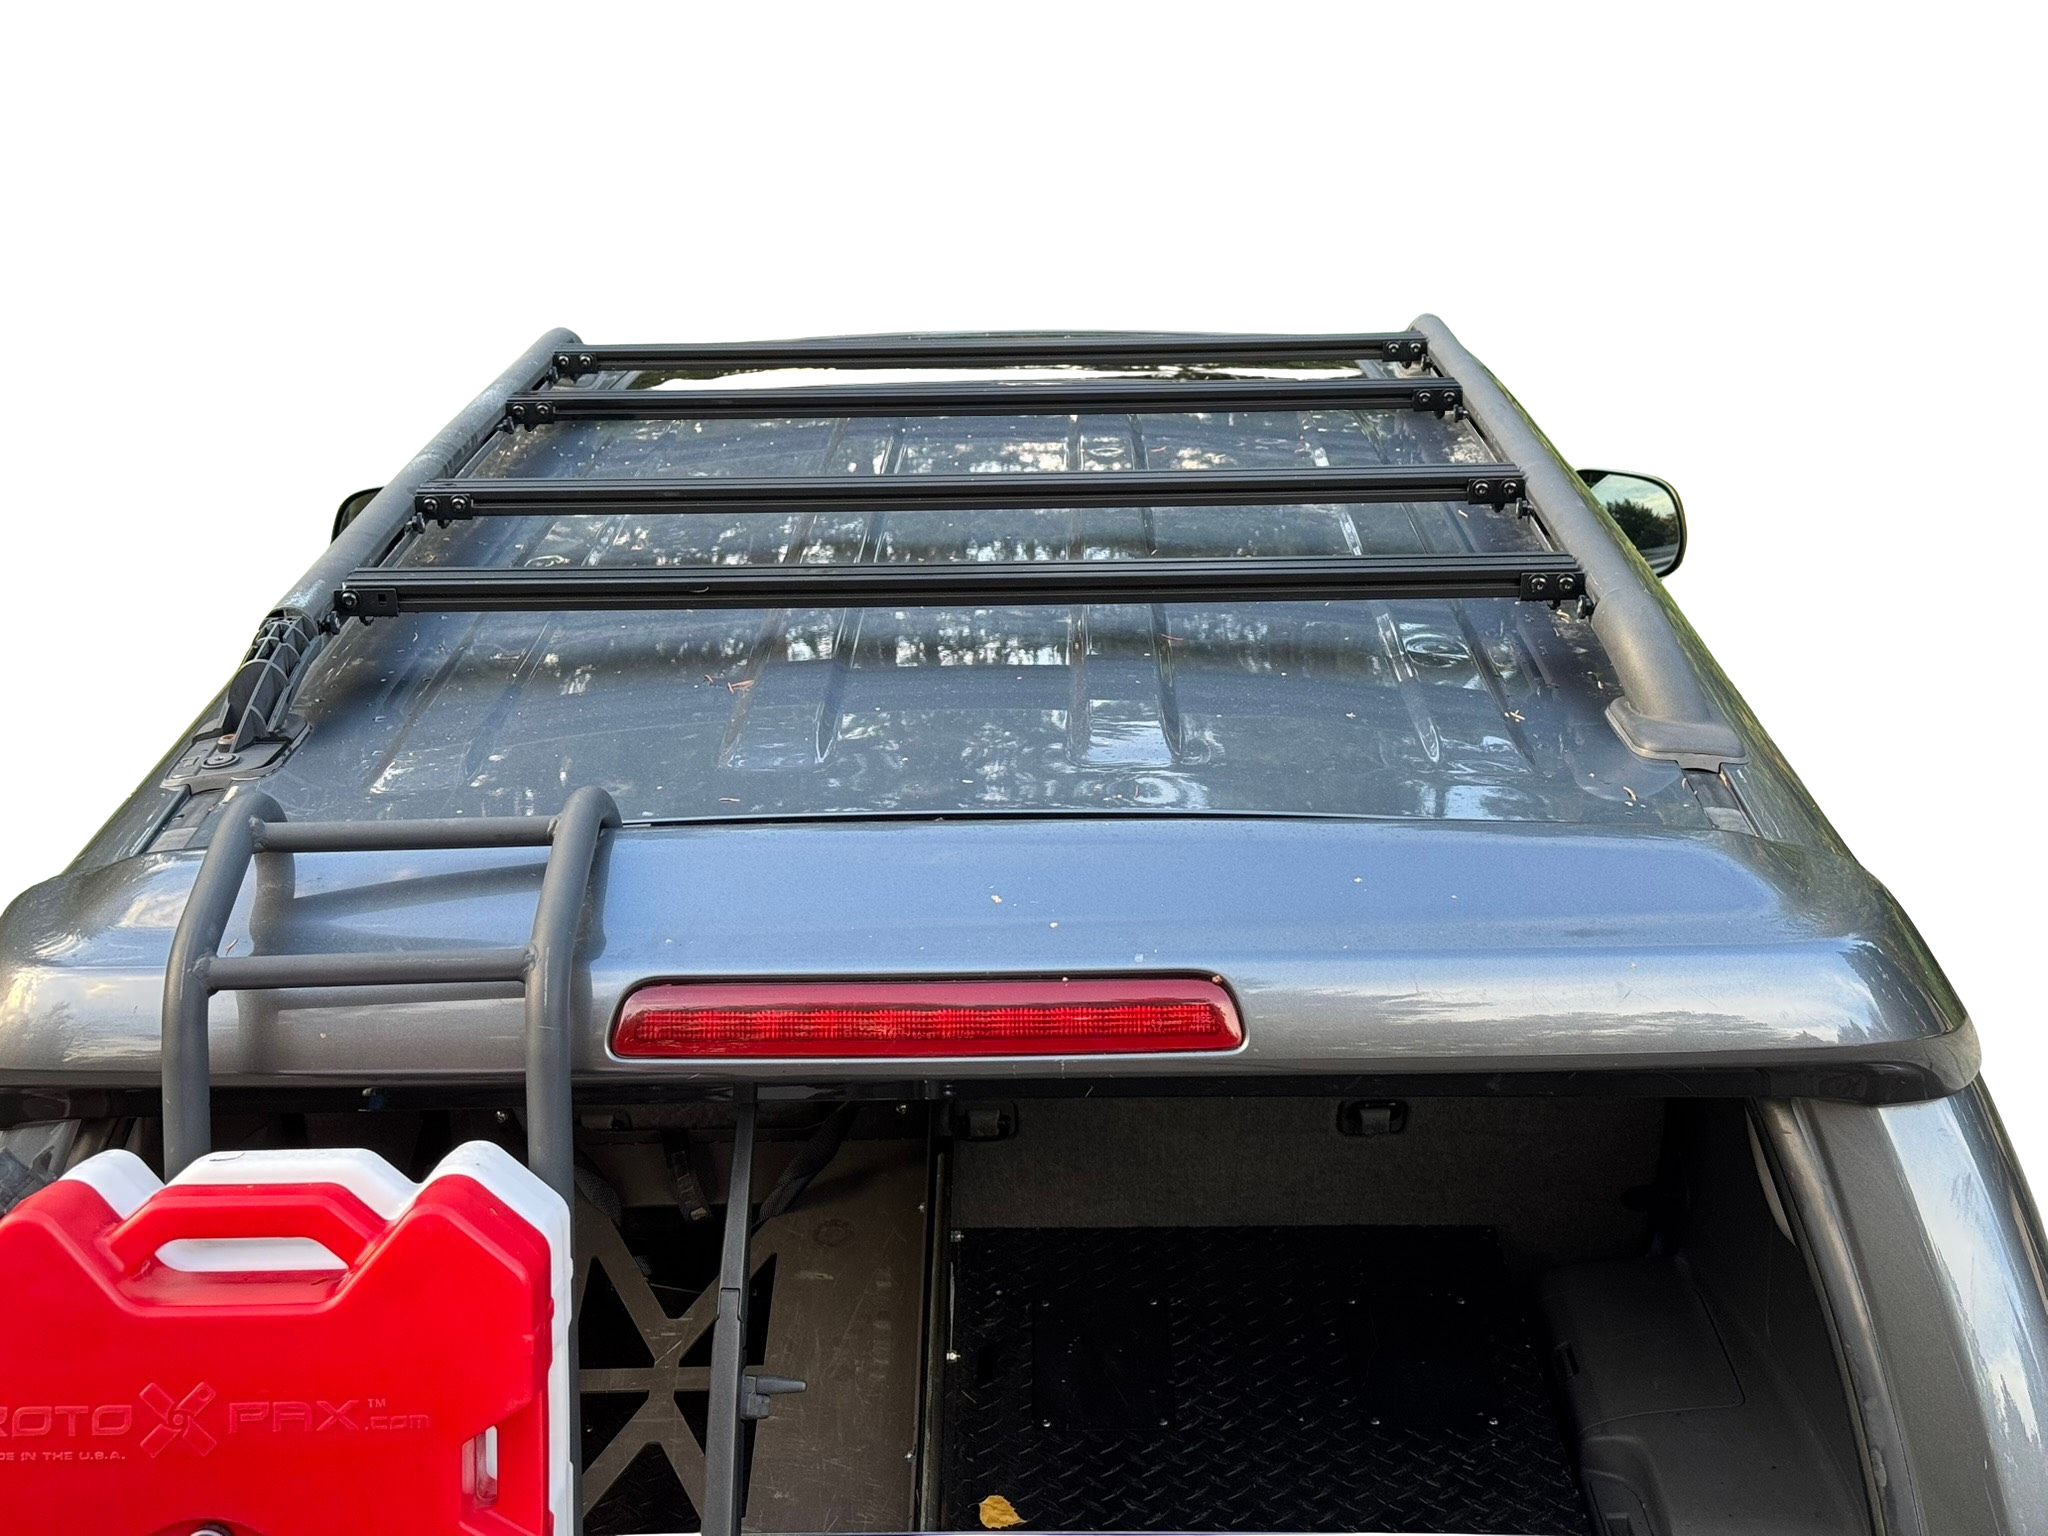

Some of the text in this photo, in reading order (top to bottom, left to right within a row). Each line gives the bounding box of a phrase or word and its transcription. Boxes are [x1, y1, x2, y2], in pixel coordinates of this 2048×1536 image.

[0, 1405, 132, 1437] OTO
[20, 1451, 37, 1461] IN
[42, 1451, 73, 1460] THE
